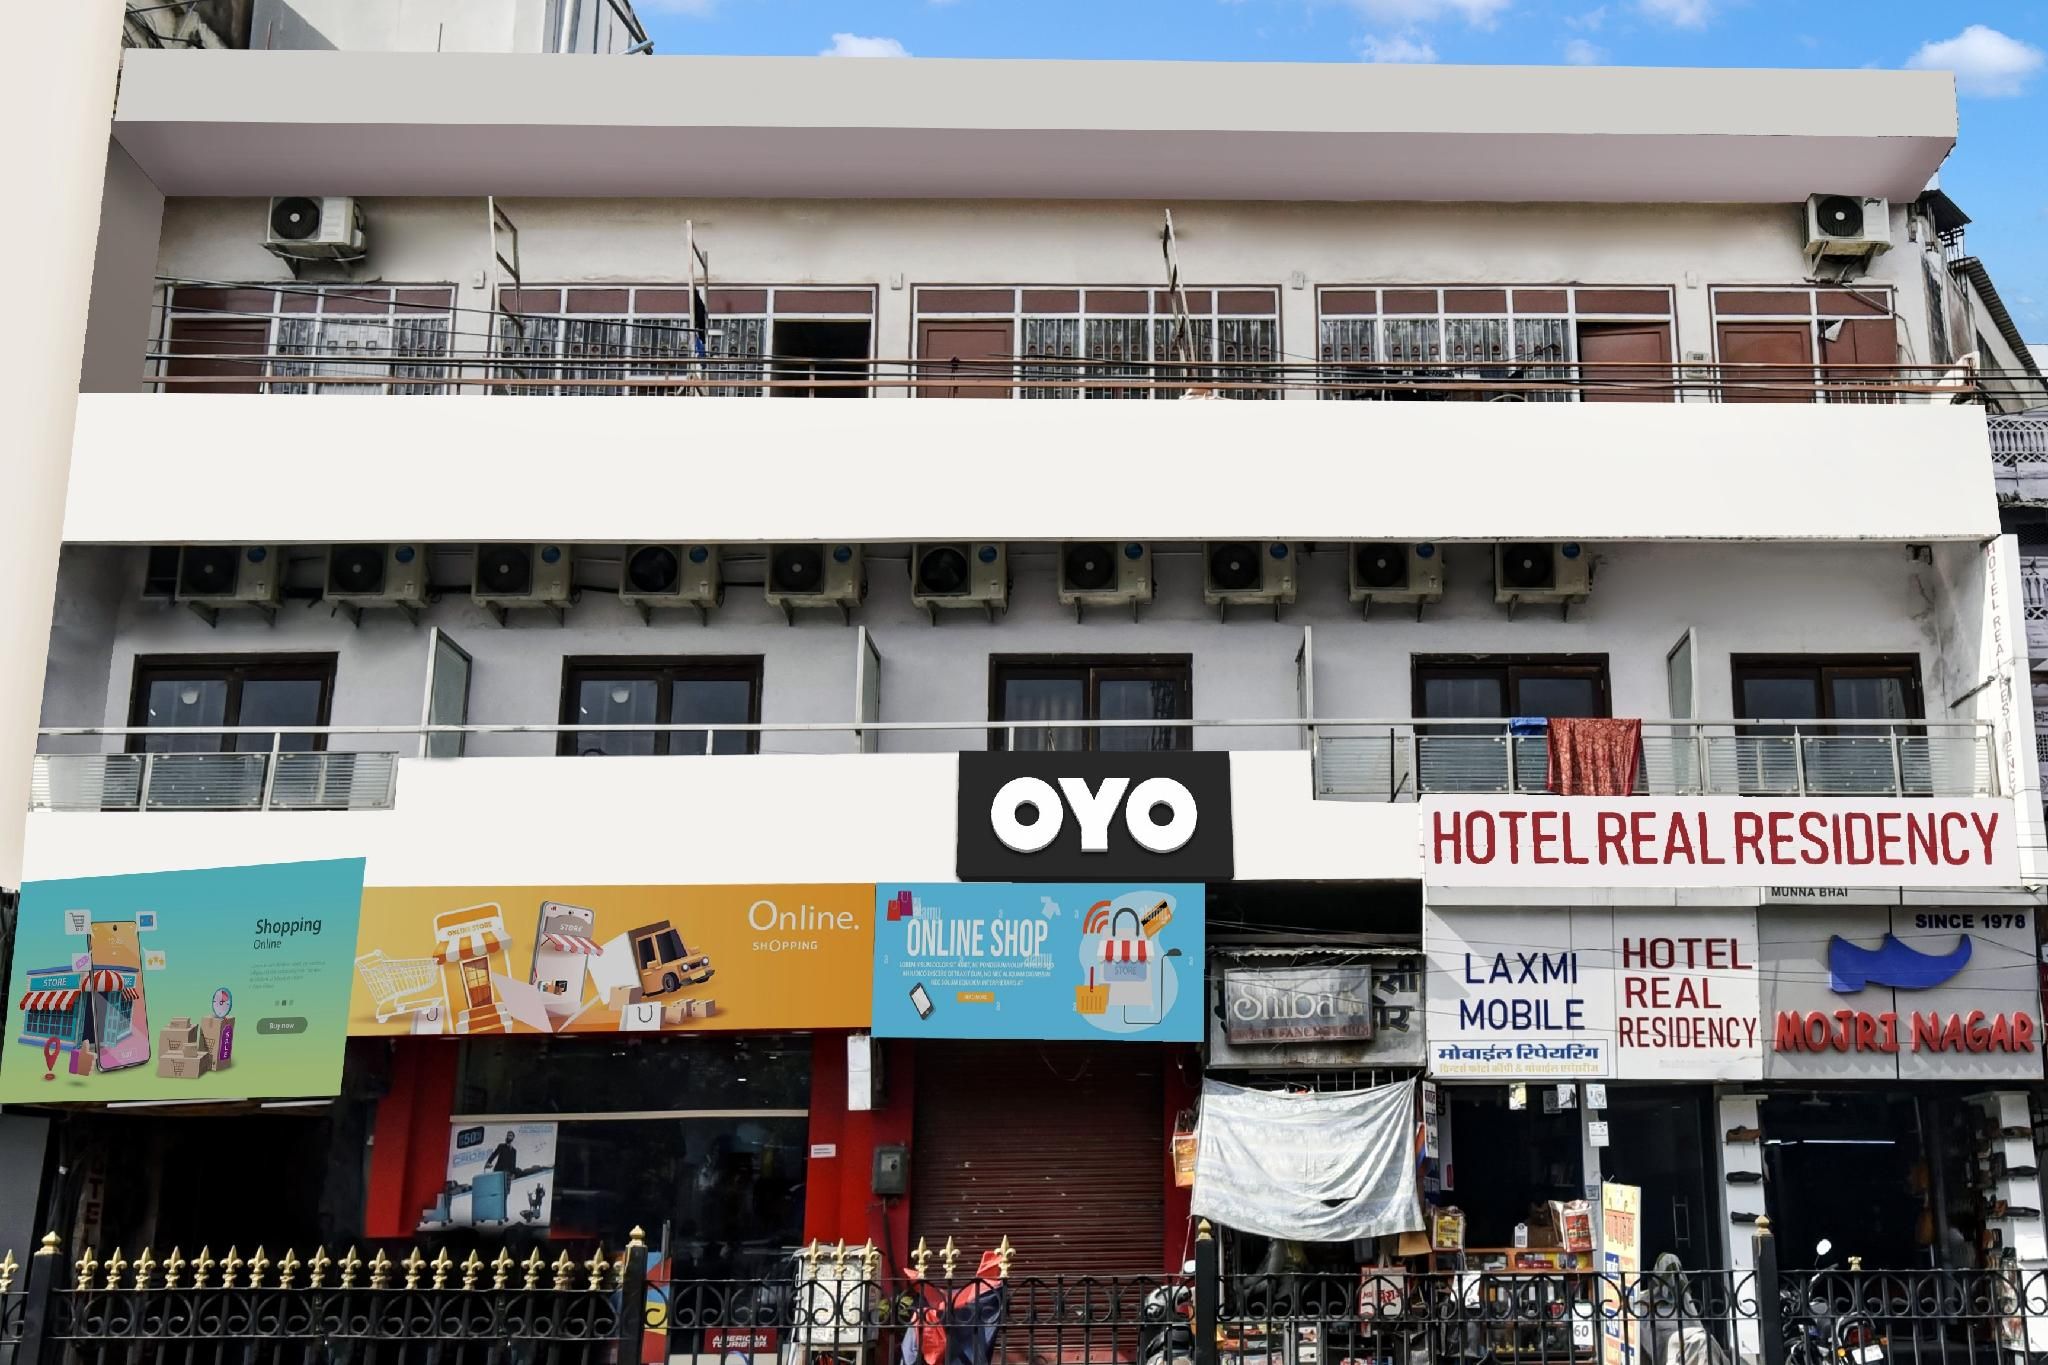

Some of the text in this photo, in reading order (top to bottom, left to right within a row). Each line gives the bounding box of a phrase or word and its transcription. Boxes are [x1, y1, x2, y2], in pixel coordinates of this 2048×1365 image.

[990, 776, 1198, 854] OYO
[1433, 810, 1999, 865] HOTEL REAL RESIDENCY
[1771, 887, 1848, 897] MUNNA BHAI
[255, 917, 322, 937] Shopping
[560, 924, 584, 933] STORE
[1915, 914, 2026, 929] SINCE 1978
[253, 938, 282, 950] Online
[752, 939, 818, 952] SHOPPING
[907, 918, 1049, 957] ONLINE SHOP
[1622, 937, 1753, 970] HOTEL
[1114, 966, 1137, 976] STORE
[1464, 952, 1578, 984] LAXMI
[43, 977, 67, 987] STORE
[1624, 977, 1722, 1009] REAL
[1234, 984, 1337, 1021] Shiba
[1460, 999, 1585, 1031] MOBILE
[269, 1022, 281, 1031] Buy
[1618, 1017, 1757, 1049] RESIDENCY
[1774, 1009, 2035, 1053] MOJRI NAGAR
[1438, 1044, 1512, 1062] मोबाईल
